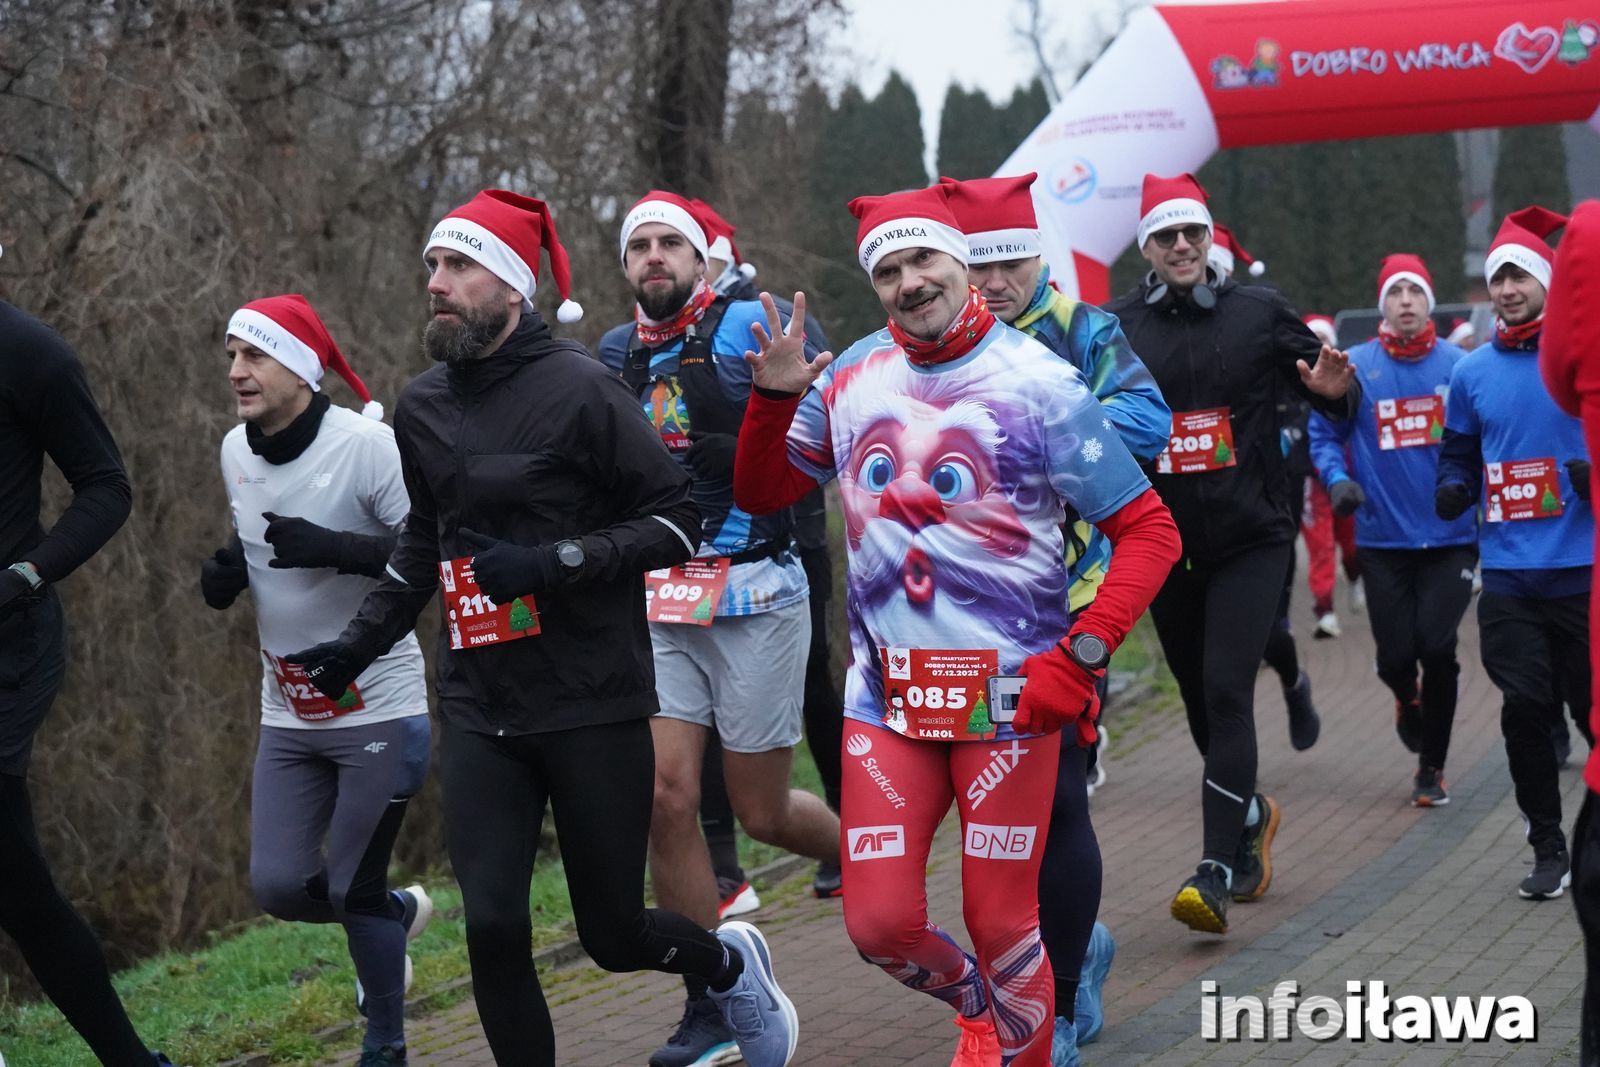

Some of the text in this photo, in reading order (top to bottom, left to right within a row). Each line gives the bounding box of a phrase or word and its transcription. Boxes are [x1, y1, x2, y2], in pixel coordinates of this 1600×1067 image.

[1290, 42, 1491, 78] DOBRO WRACA
[447, 230, 483, 252] WRACA
[884, 227, 928, 241] WRACA
[970, 243, 1026, 257] BRO WRACA
[1171, 433, 1214, 453] 208
[1501, 483, 1537, 501] 160
[658, 583, 703, 602] 009
[470, 633, 499, 645] PAWEŁ
[932, 669, 979, 677] 07.12.2025
[906, 685, 967, 709] 085
[919, 728, 955, 738] KAROL
[363, 741, 388, 753] 4F
[861, 757, 906, 809] Statkraft
[971, 830, 1028, 855] DNB
